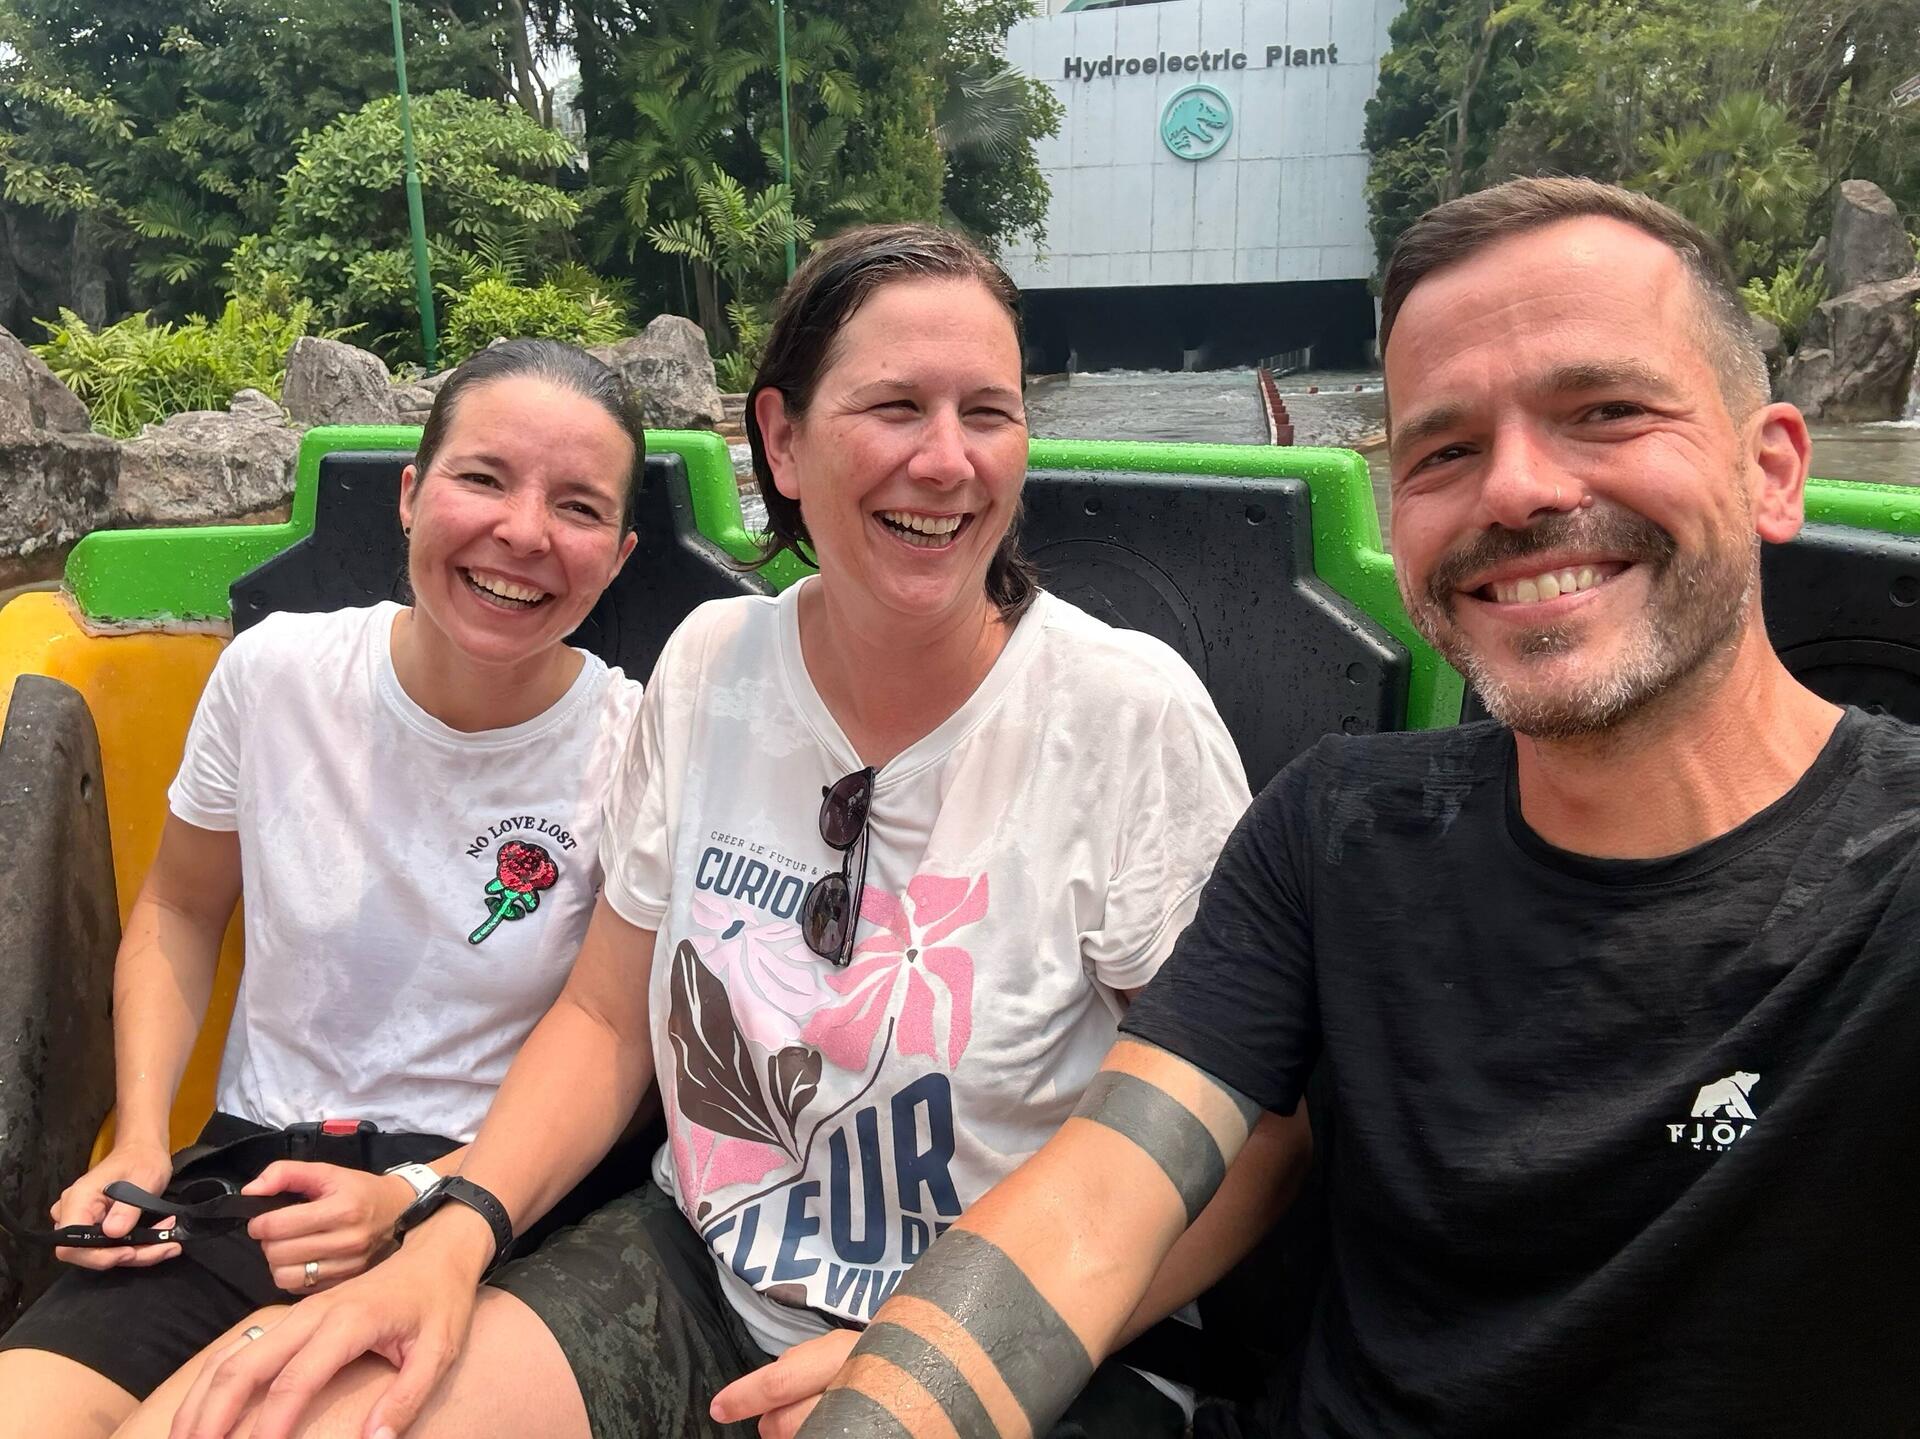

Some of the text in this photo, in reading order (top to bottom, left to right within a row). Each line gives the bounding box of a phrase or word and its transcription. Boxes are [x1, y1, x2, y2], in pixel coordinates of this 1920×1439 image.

[1063, 43, 1338, 82] Hydroelectric Plant
[466, 816, 577, 859] NO LOVE LOST
[710, 830, 745, 848] CRÉER
[750, 842, 765, 855] LE
[769, 852, 807, 873] FUTUR
[811, 866, 818, 875] &
